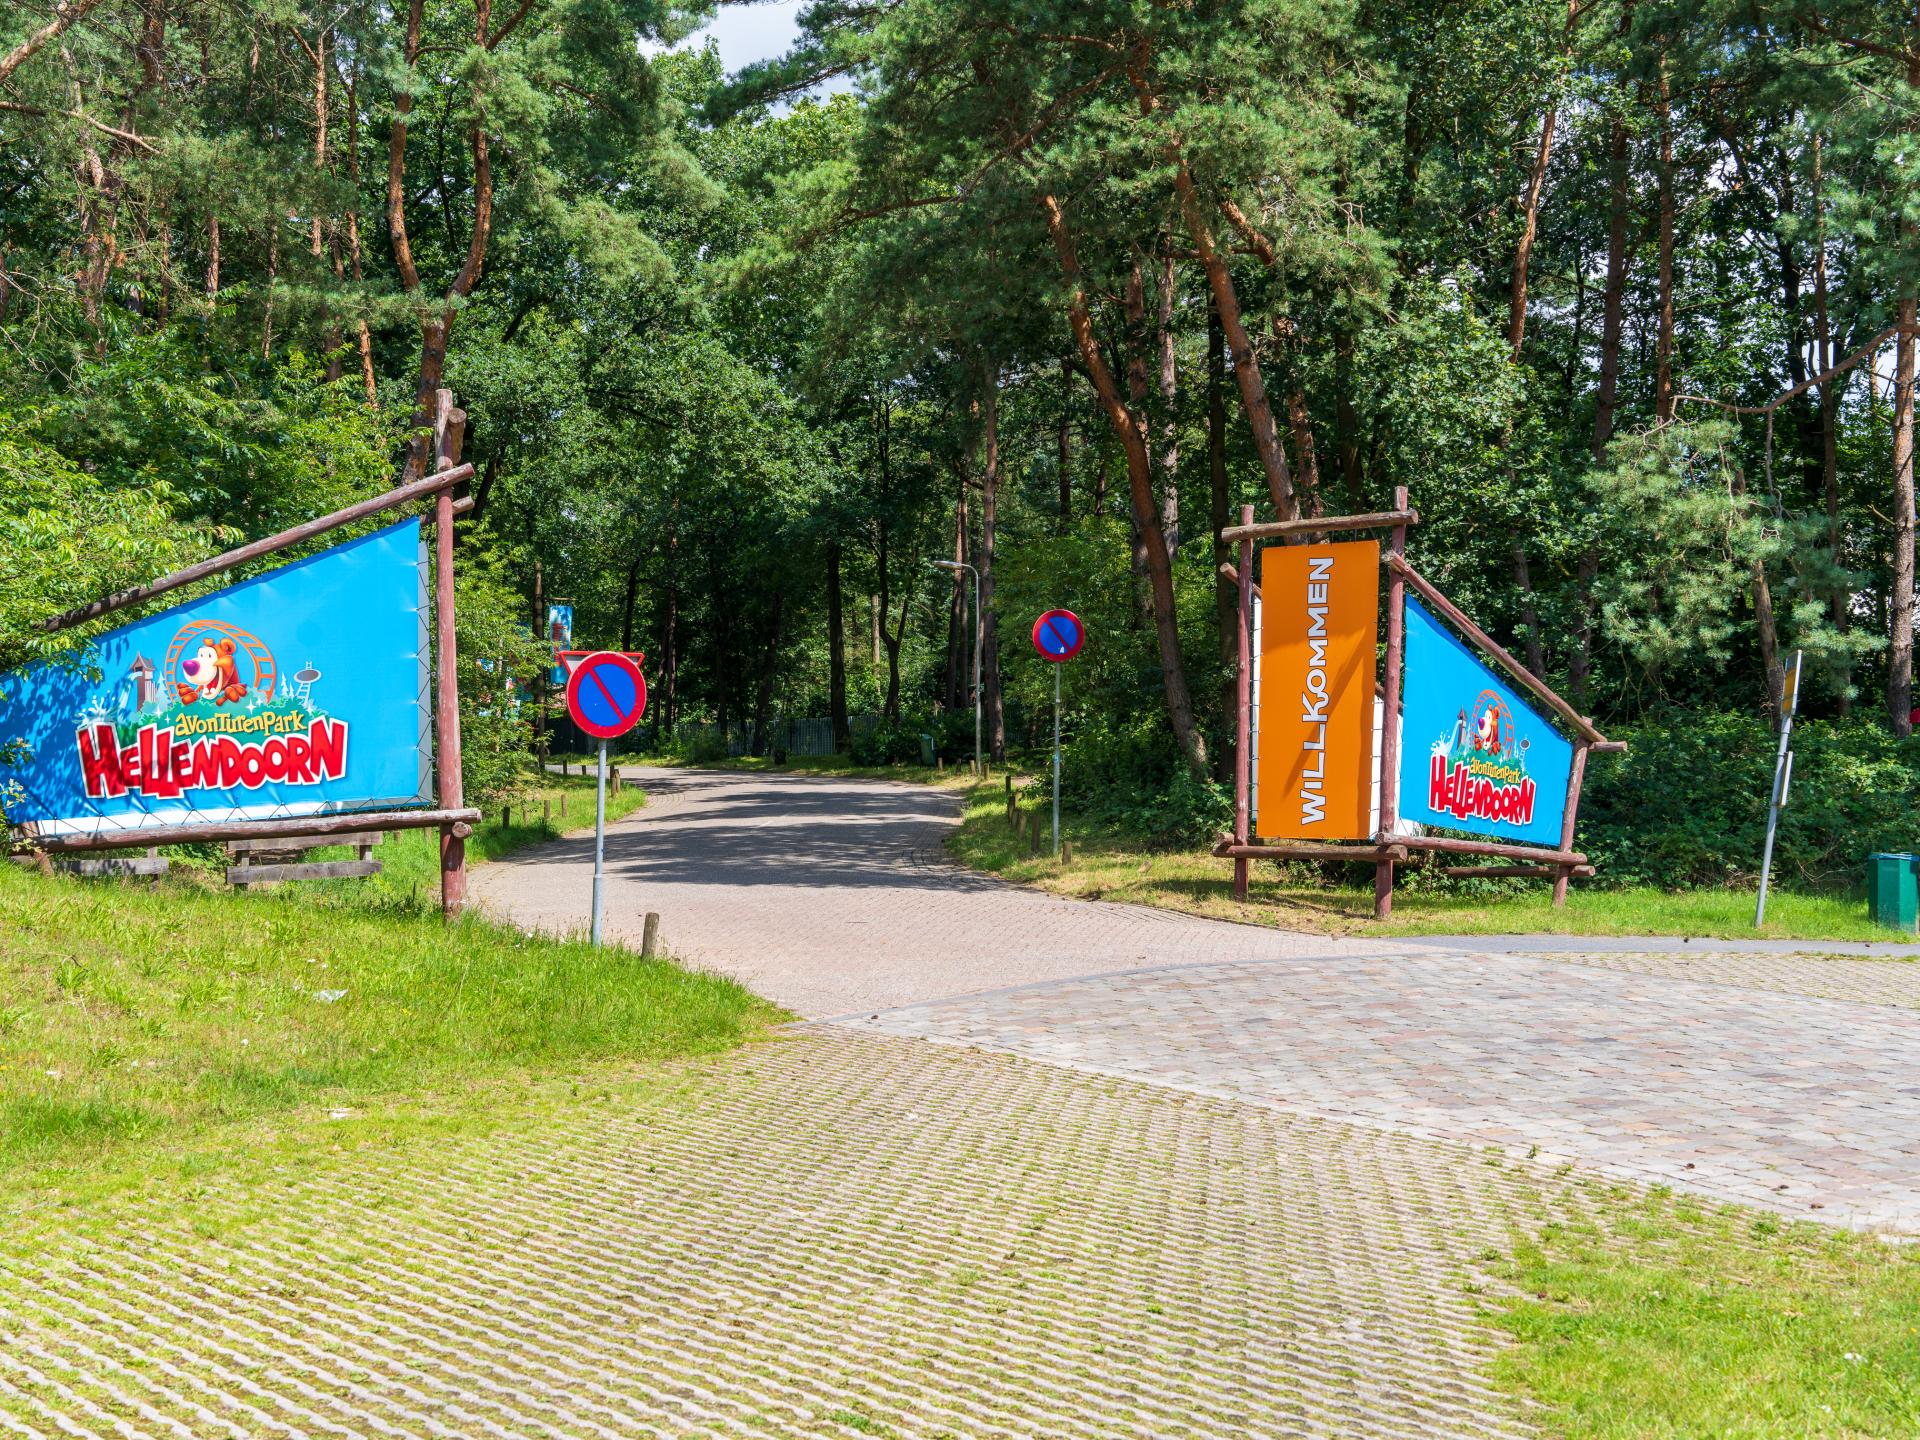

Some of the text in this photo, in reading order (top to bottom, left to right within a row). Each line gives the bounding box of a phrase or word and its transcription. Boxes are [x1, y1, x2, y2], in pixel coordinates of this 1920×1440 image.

[1300, 557, 1334, 825] WILLKOMMEN
[76, 715, 349, 799] HELLENDOORN
[1428, 755, 1536, 825] HELLENDOORN
